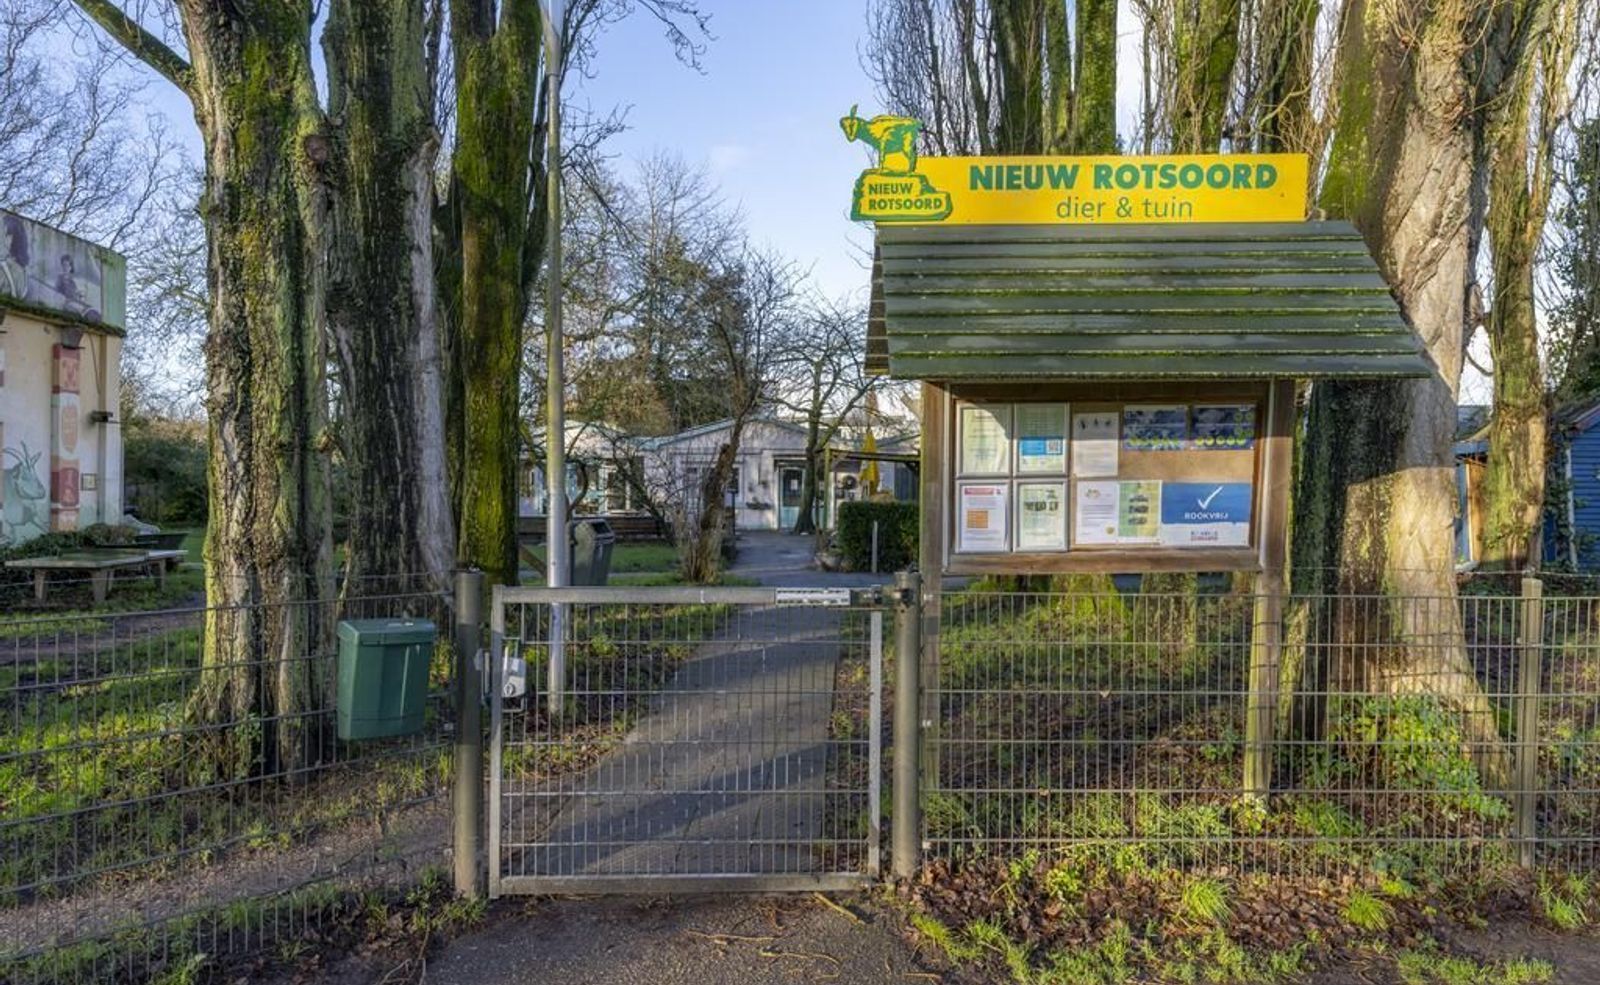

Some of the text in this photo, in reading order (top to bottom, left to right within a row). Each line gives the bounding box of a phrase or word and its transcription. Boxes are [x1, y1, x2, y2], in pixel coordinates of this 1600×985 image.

[970, 163, 1278, 190] NIEUW ROTSOORD
[868, 183, 914, 195] NIEUW
[868, 198, 942, 210] ROTSOORD
[1056, 196, 1193, 218] dier & tuin
